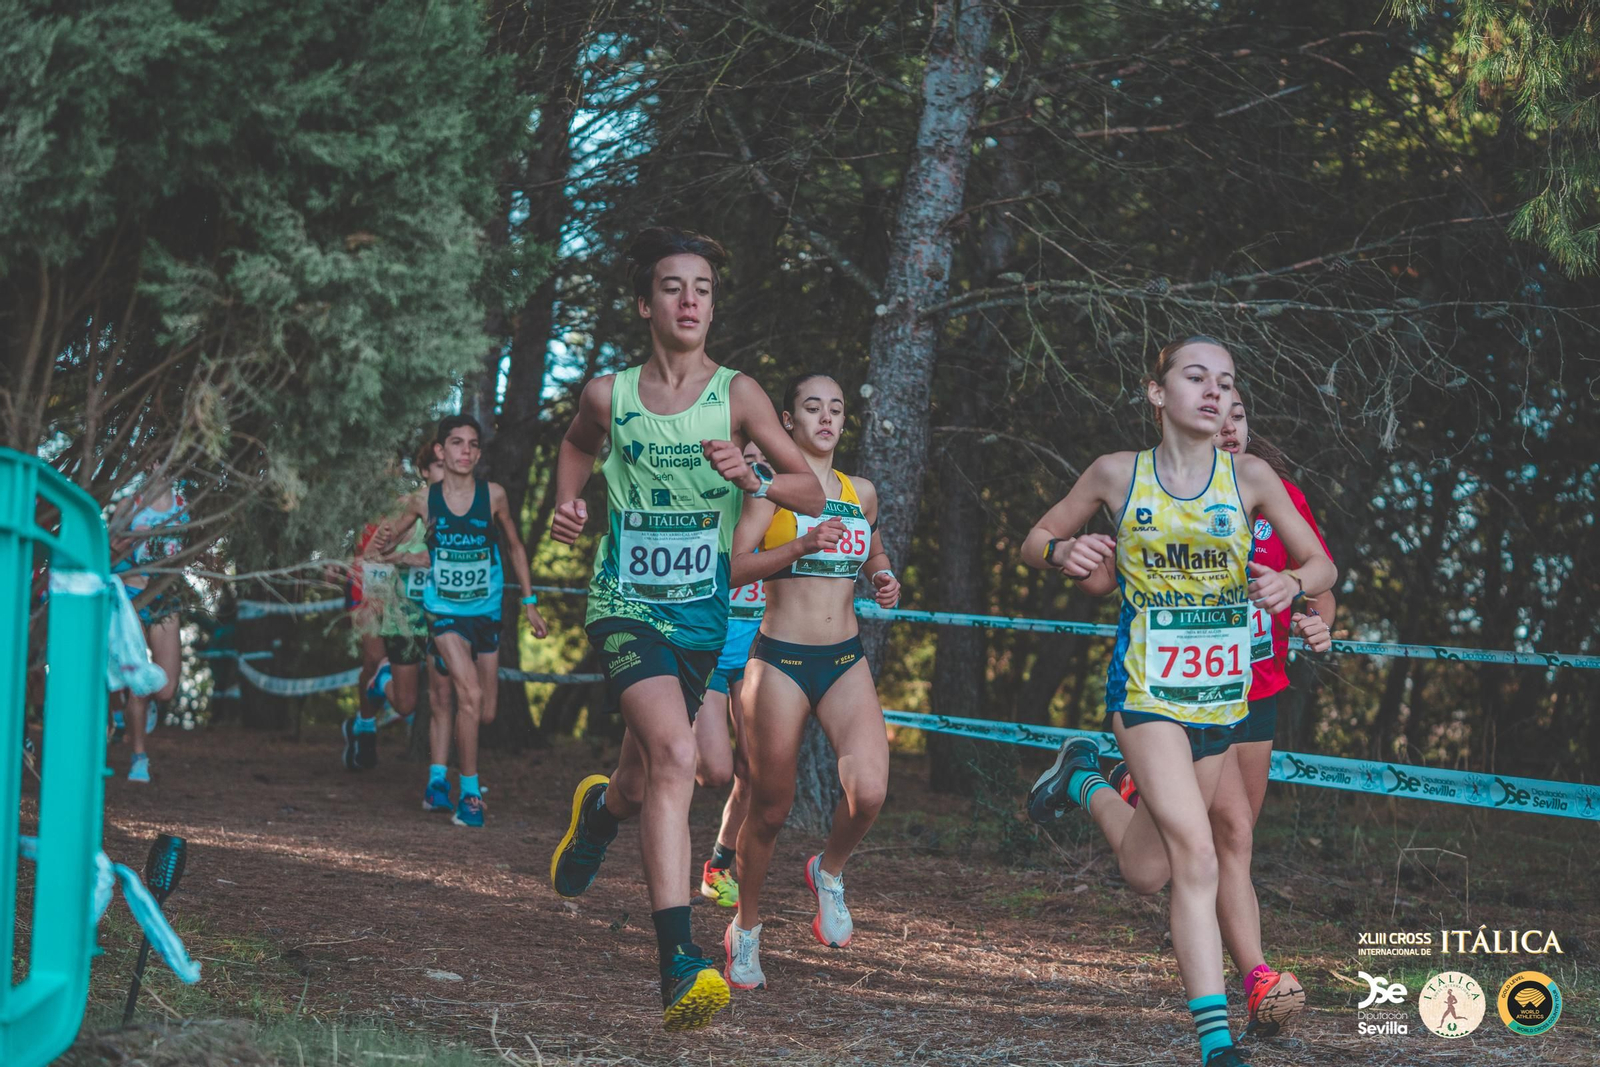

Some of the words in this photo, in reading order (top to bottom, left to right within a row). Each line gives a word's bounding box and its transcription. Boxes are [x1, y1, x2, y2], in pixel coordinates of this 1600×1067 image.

[649, 454, 702, 471] Unicaja
[651, 472, 674, 481] Jaén
[648, 513, 698, 526] ITÁLICA
[629, 544, 711, 577] 8040
[440, 568, 488, 588] 5892
[1180, 610, 1227, 623] ITÁLICA
[608, 650, 637, 669] Unicaja
[1157, 644, 1243, 679] 7361
[1319, 772, 1351, 785] Sevilla
[1423, 783, 1456, 798] Sevilla
[1531, 787, 1568, 799] Diputación
[1532, 796, 1568, 811] Sevilla
